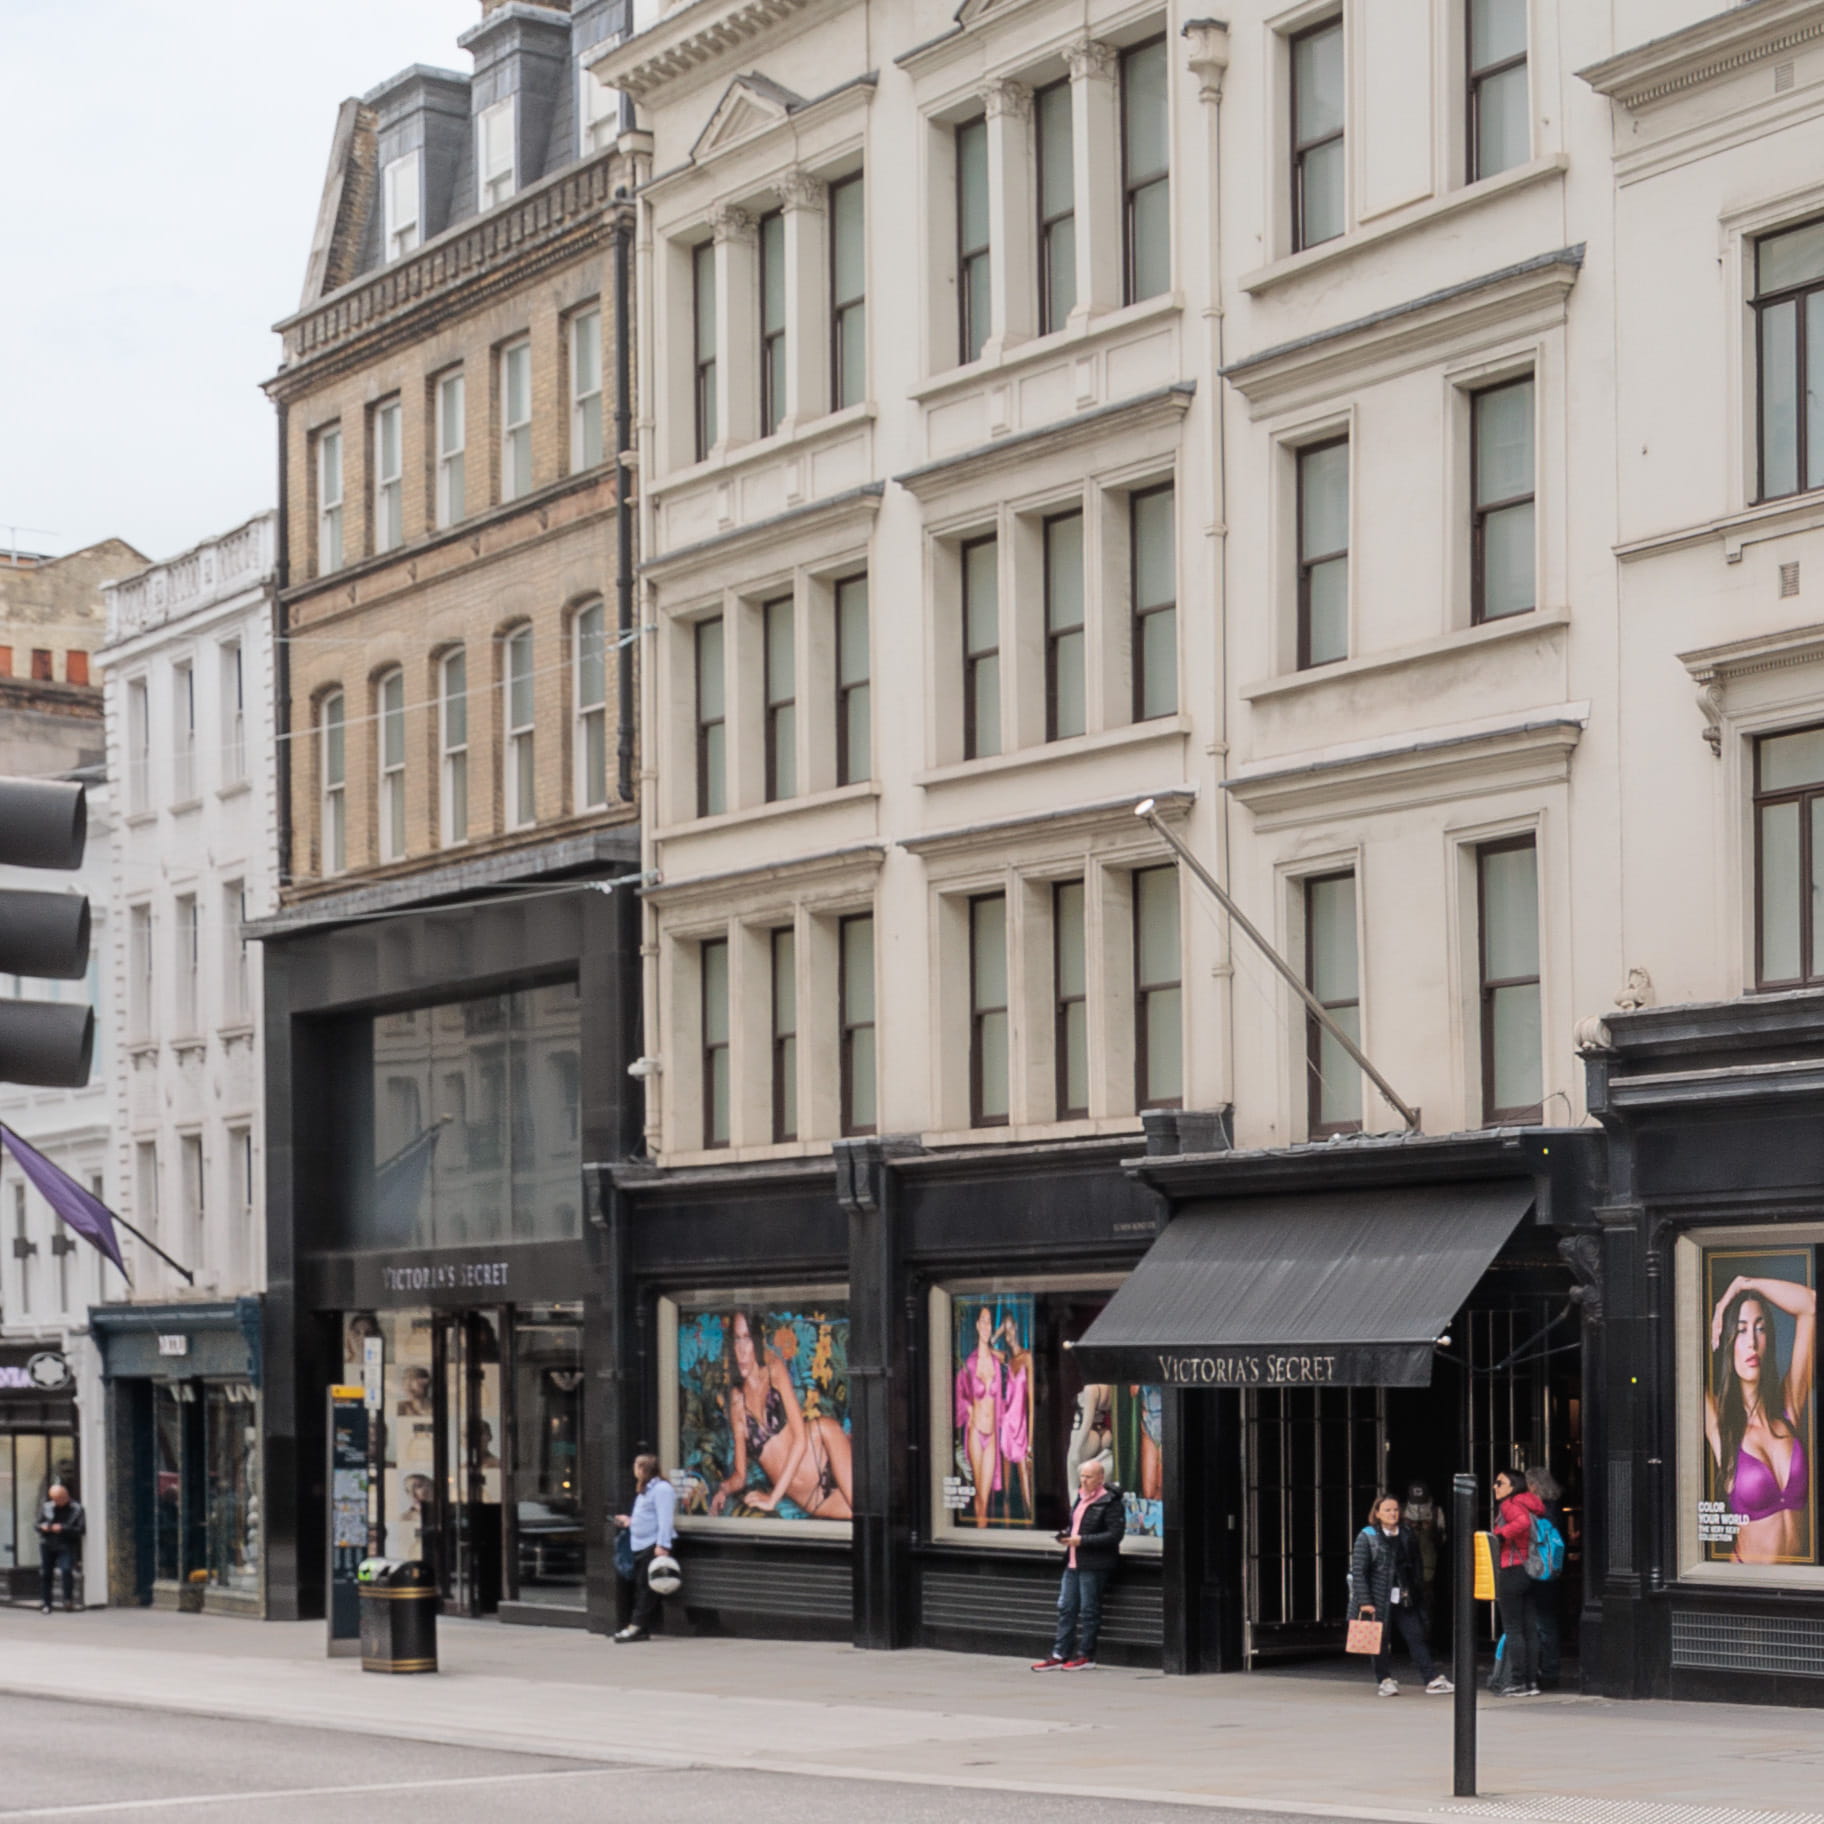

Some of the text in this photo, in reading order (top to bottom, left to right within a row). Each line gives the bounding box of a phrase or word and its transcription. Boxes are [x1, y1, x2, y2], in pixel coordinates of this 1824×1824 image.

[382, 1262, 509, 1291] VICTORIA'S SECRET
[1157, 1353, 1336, 1383] VICTORIA'S SECRET
[1698, 1501, 1726, 1513] COLOR
[1698, 1513, 1750, 1525] YOUR WORLD
